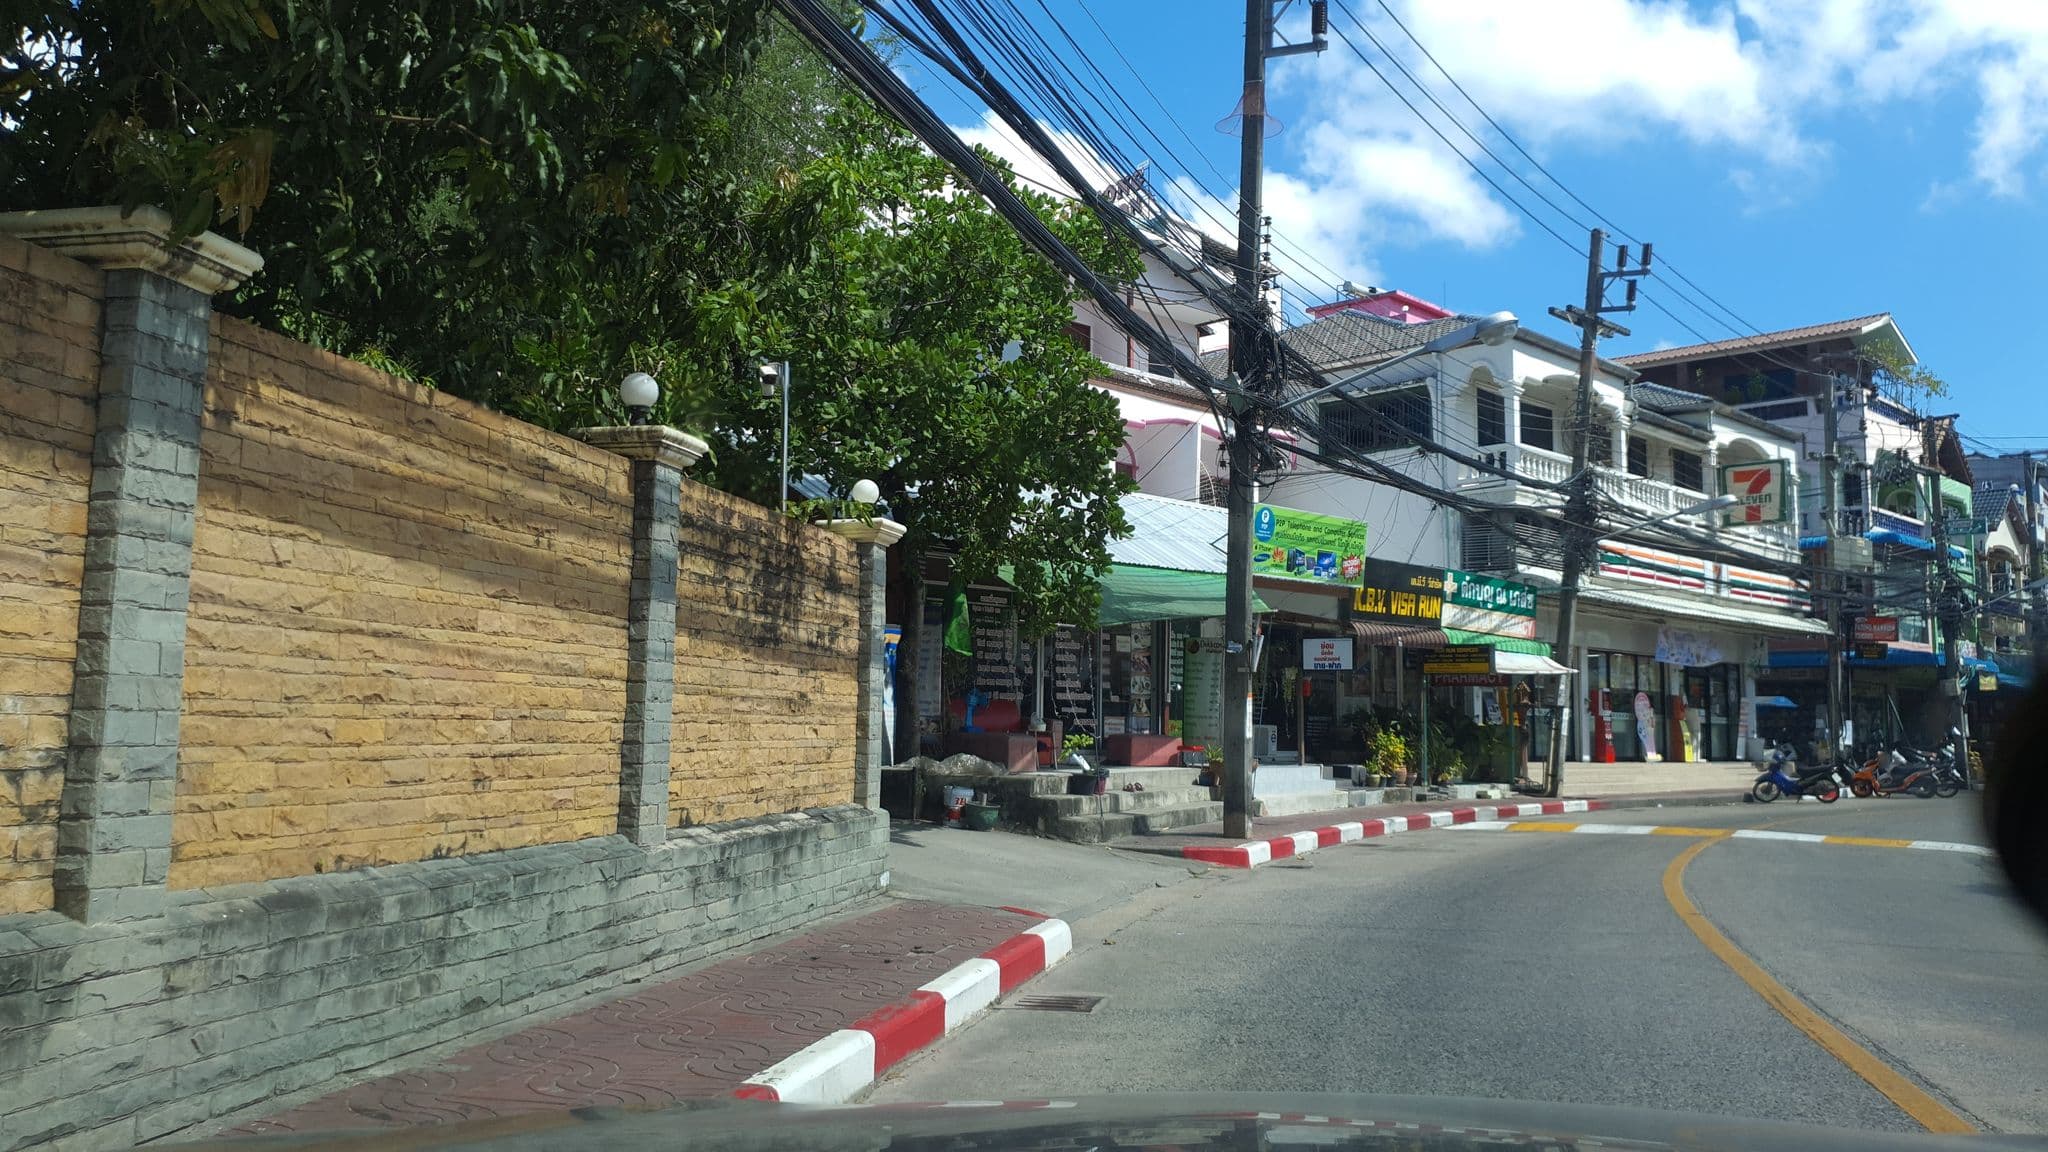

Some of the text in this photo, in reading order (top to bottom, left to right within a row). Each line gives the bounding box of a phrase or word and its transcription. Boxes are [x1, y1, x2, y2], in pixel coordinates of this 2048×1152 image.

[1733, 468, 1771, 522] 7
[1353, 587, 1442, 619] K.B.V. VISA RUN
